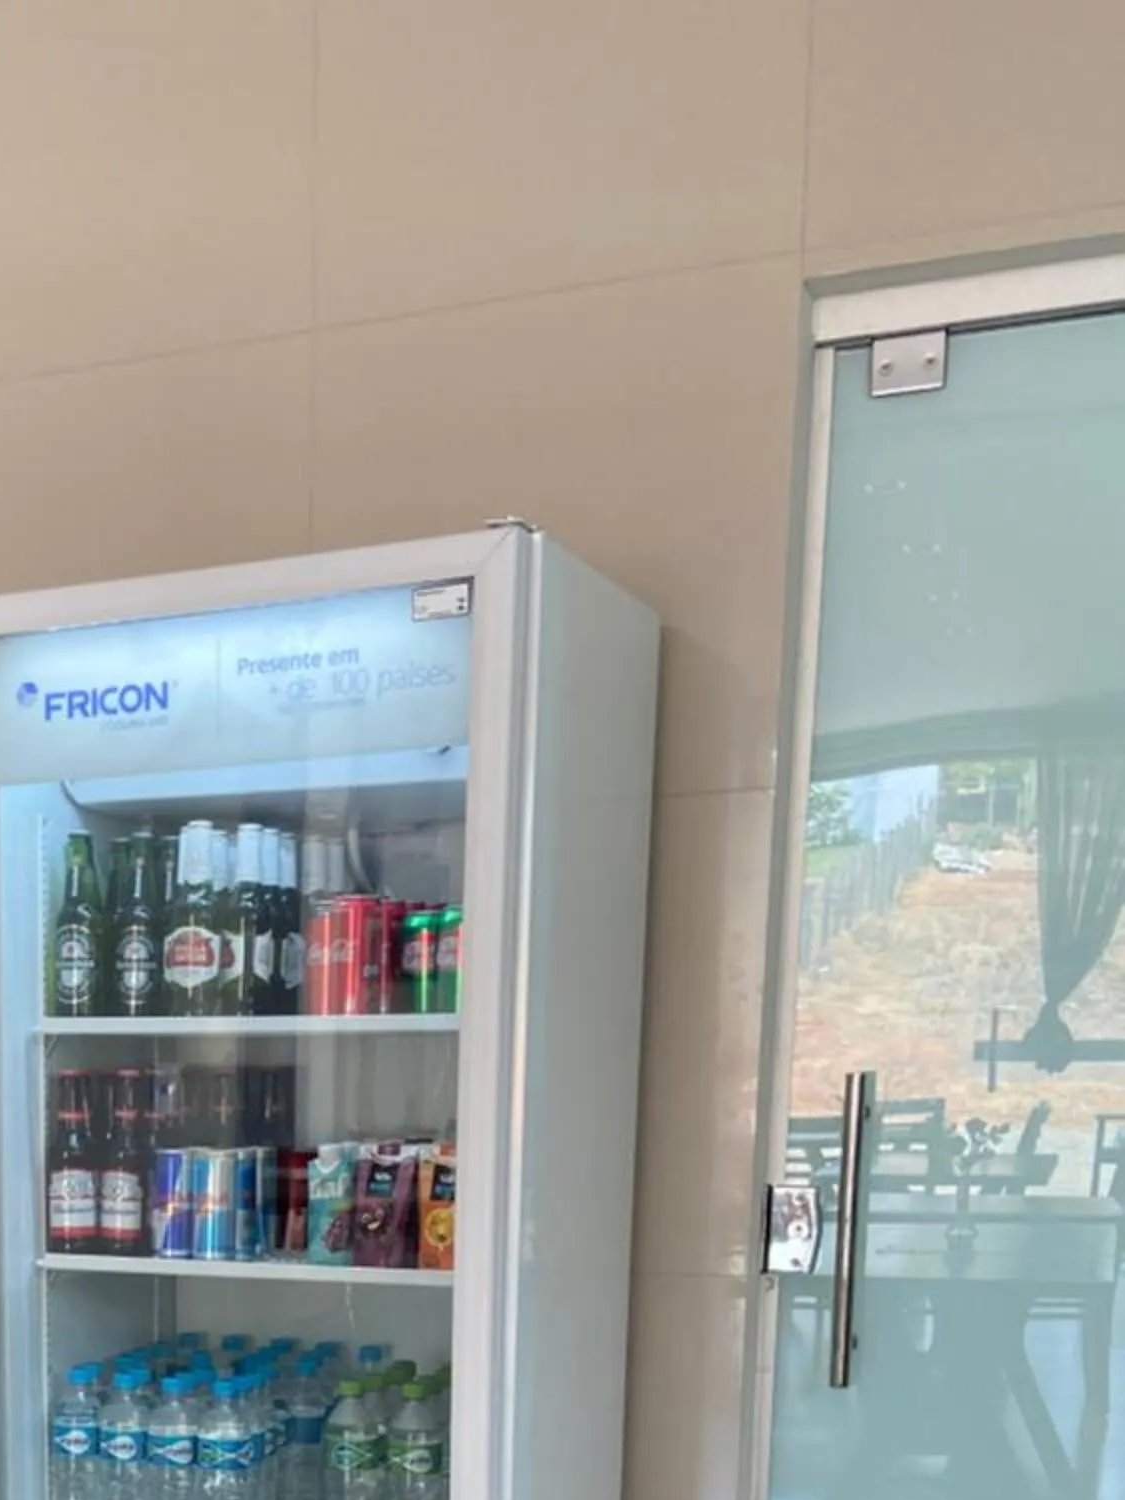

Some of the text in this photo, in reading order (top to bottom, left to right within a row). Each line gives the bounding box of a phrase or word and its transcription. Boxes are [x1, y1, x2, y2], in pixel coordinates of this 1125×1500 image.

[236, 647, 360, 677] Presente em
[44, 680, 169, 722] FRICON
